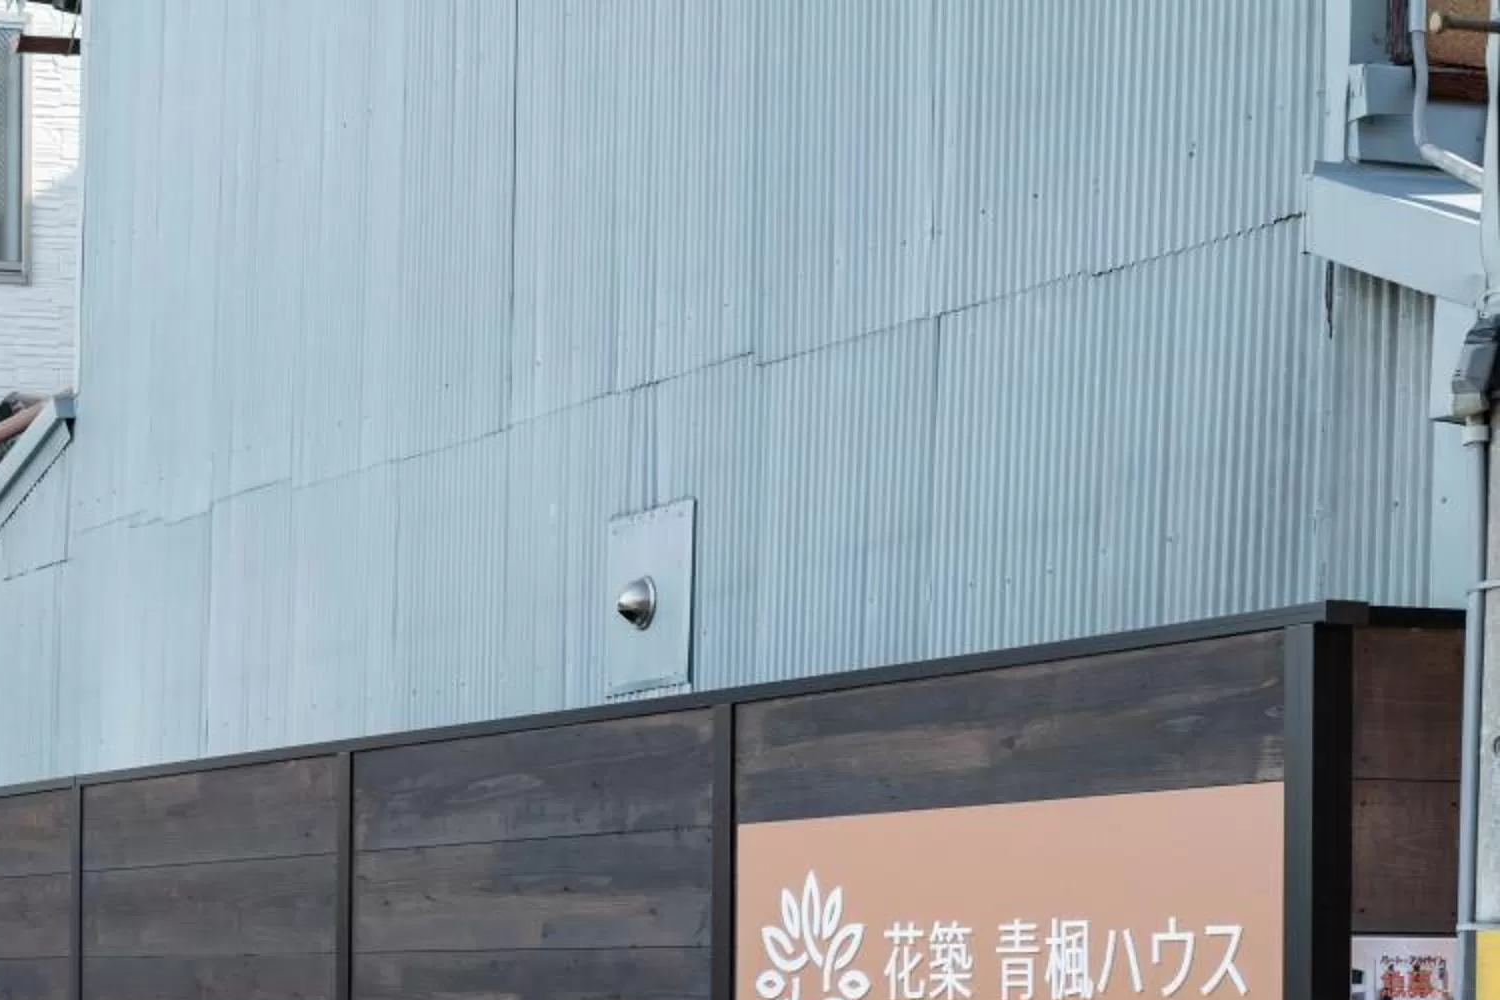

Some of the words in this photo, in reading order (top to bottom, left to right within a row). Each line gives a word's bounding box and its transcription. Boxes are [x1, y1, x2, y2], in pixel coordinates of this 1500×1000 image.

[883, 919, 975, 1000] 花築
[995, 914, 1249, 1000] 青楓ハウス
